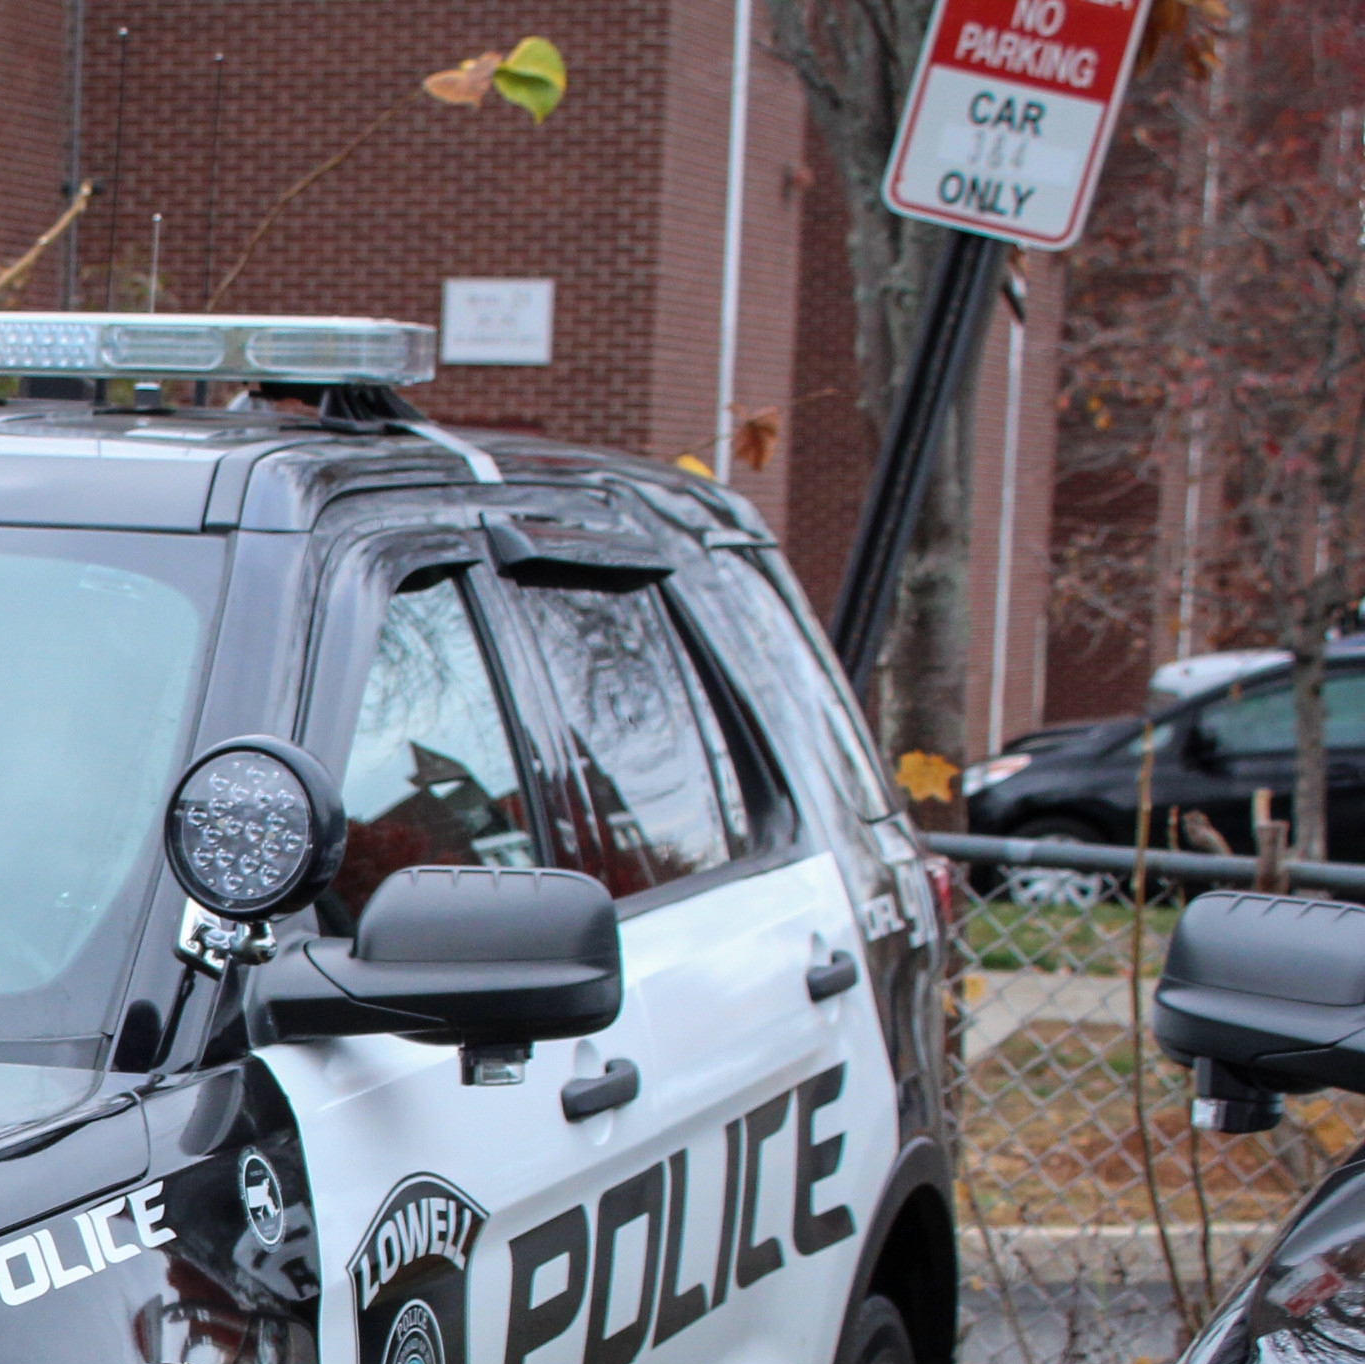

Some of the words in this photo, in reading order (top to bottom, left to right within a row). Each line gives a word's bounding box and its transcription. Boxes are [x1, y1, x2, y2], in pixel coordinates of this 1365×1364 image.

[1011, 0, 1066, 37] NO
[954, 22, 1098, 89] PARKING
[969, 91, 1045, 136] CAR
[939, 170, 1035, 219] ONLY
[360, 1197, 472, 1310] LOWELL
[396, 1307, 429, 1343] POLICE
